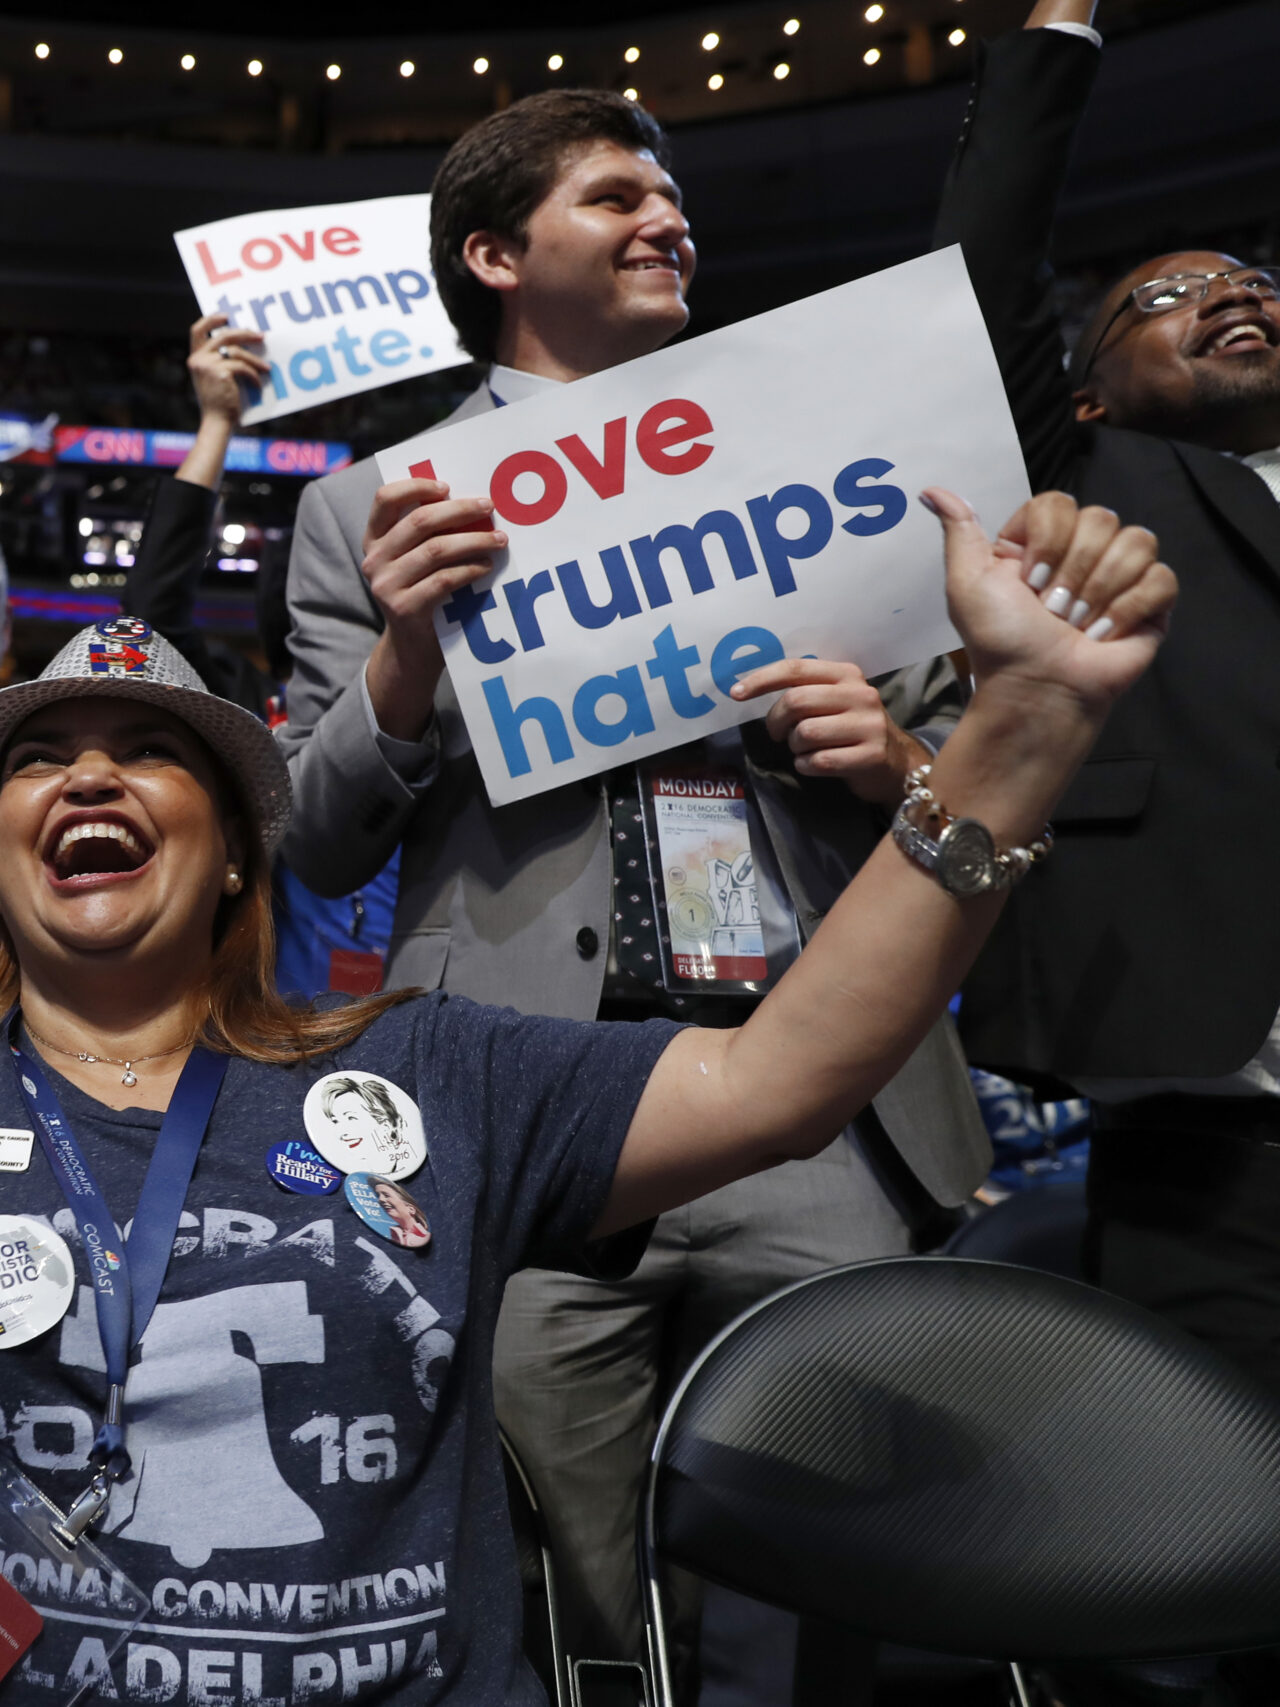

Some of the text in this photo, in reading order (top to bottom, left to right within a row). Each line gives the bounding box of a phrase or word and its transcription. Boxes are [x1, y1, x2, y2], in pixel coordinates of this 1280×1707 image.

[194, 226, 362, 286] Love
[216, 268, 434, 332] trump
[83, 429, 145, 463] CNN
[267, 440, 326, 474] CNN
[443, 458, 907, 664] trumps
[659, 777, 737, 798] MONDAY
[36, 1112, 83, 1196] NATIONAL CONVENTION
[59, 1140, 95, 1197] DEMOCRATIC
[275, 1163, 333, 1189] Hillary
[276, 1153, 333, 1175] Ready for
[352, 1189, 377, 1200] ELLA
[356, 1197, 381, 1208] Voto
[83, 1223, 114, 1297] COMCAST
[289, 1410, 398, 1485] 16
[151, 1560, 446, 1624] CONVENTION
